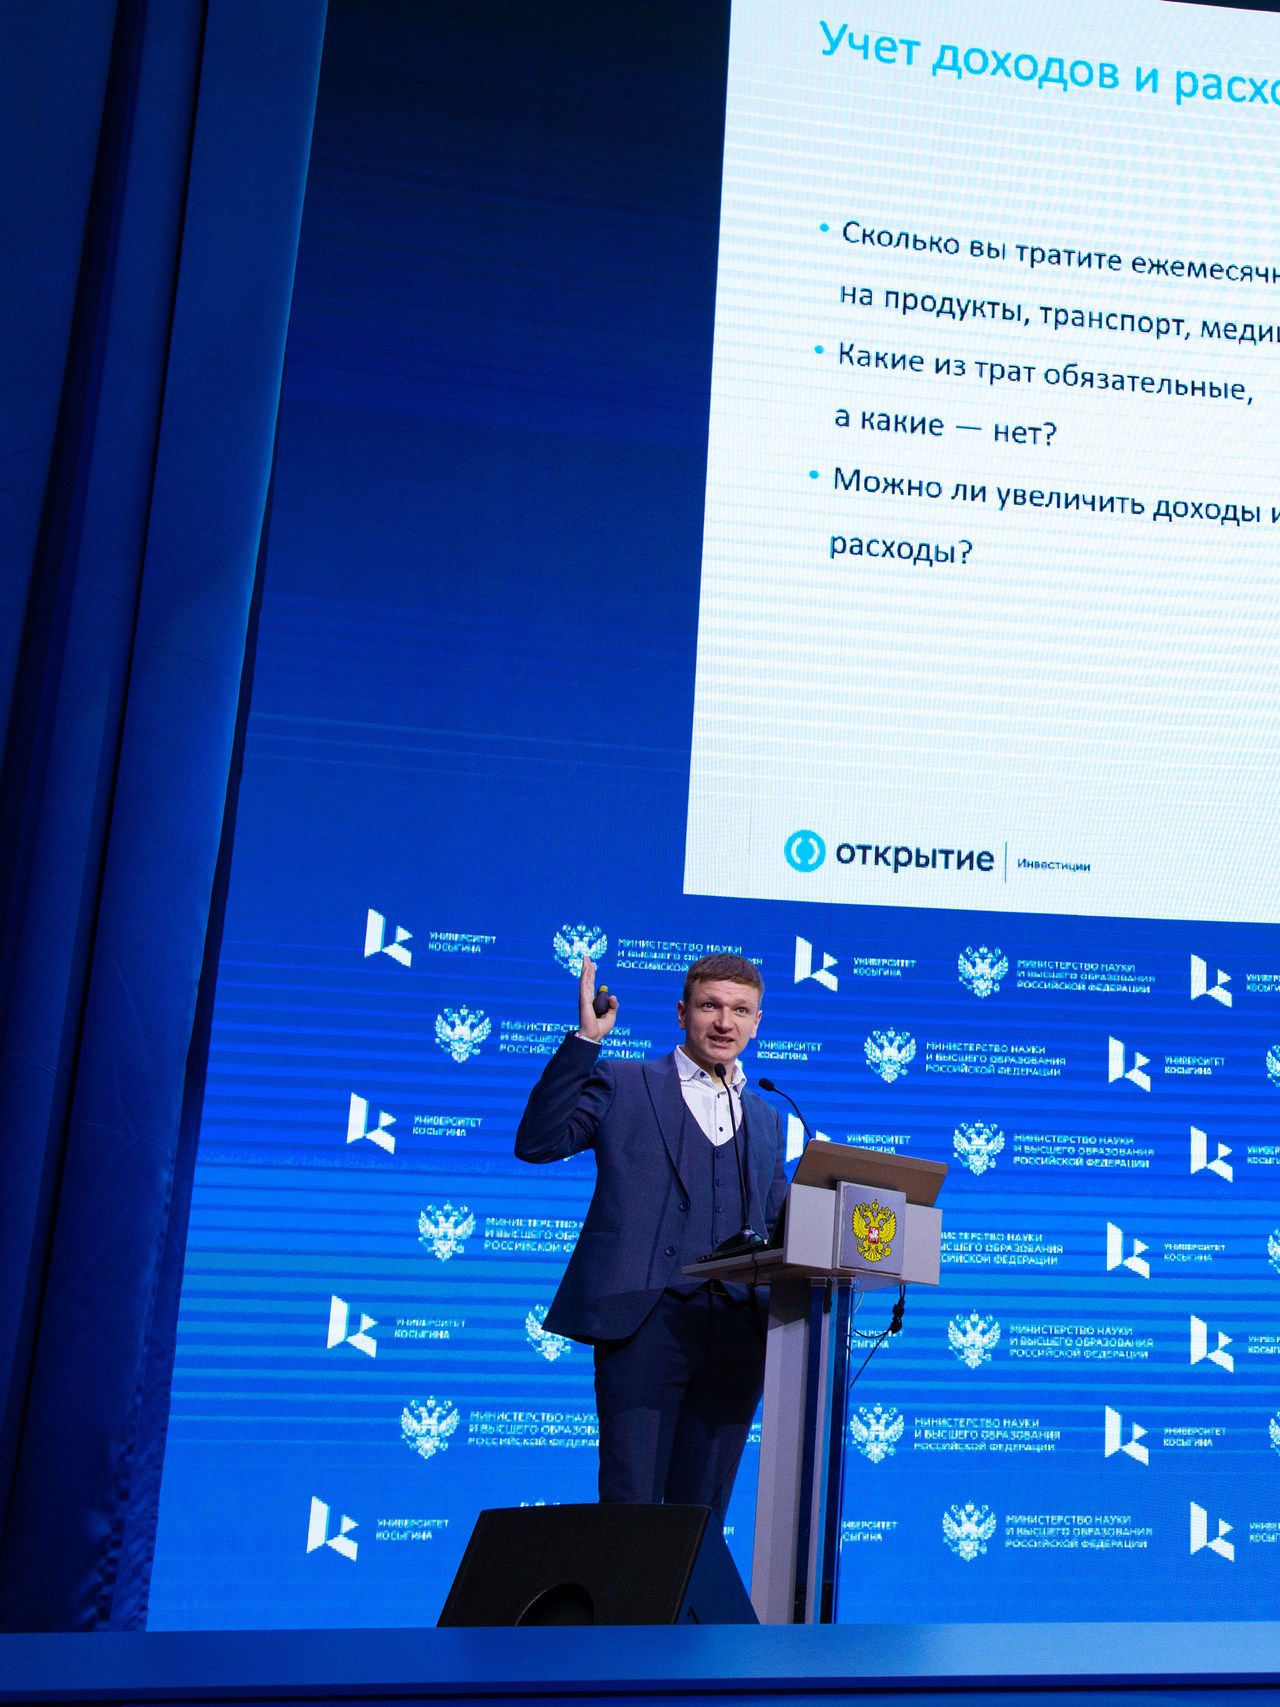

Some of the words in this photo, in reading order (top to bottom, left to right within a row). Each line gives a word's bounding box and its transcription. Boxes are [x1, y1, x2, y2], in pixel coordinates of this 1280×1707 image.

[818, 19, 922, 67] Учет
[931, 43, 1120, 93] доходов
[1134, 65, 1160, 94] и
[842, 219, 961, 255] Сколько
[969, 239, 1007, 260] вы
[1015, 243, 1123, 271] тратите
[840, 285, 874, 306] на
[884, 289, 1030, 326] продукты,
[1039, 305, 1191, 340] транспорт,
[838, 342, 925, 372] Какие
[934, 357, 966, 377] из
[975, 360, 1036, 386] трат
[1043, 362, 1253, 405] обязательные,
[834, 407, 851, 428] а
[860, 411, 945, 437] какие
[993, 421, 1058, 446] нет?
[833, 466, 943, 499] Можно
[950, 483, 987, 502] ли
[996, 487, 1146, 515] увеличить
[1152, 499, 1262, 527] доходы
[829, 535, 973, 567] расходы?
[835, 842, 996, 874] открытие
[1017, 858, 1092, 873] Инвестиции
